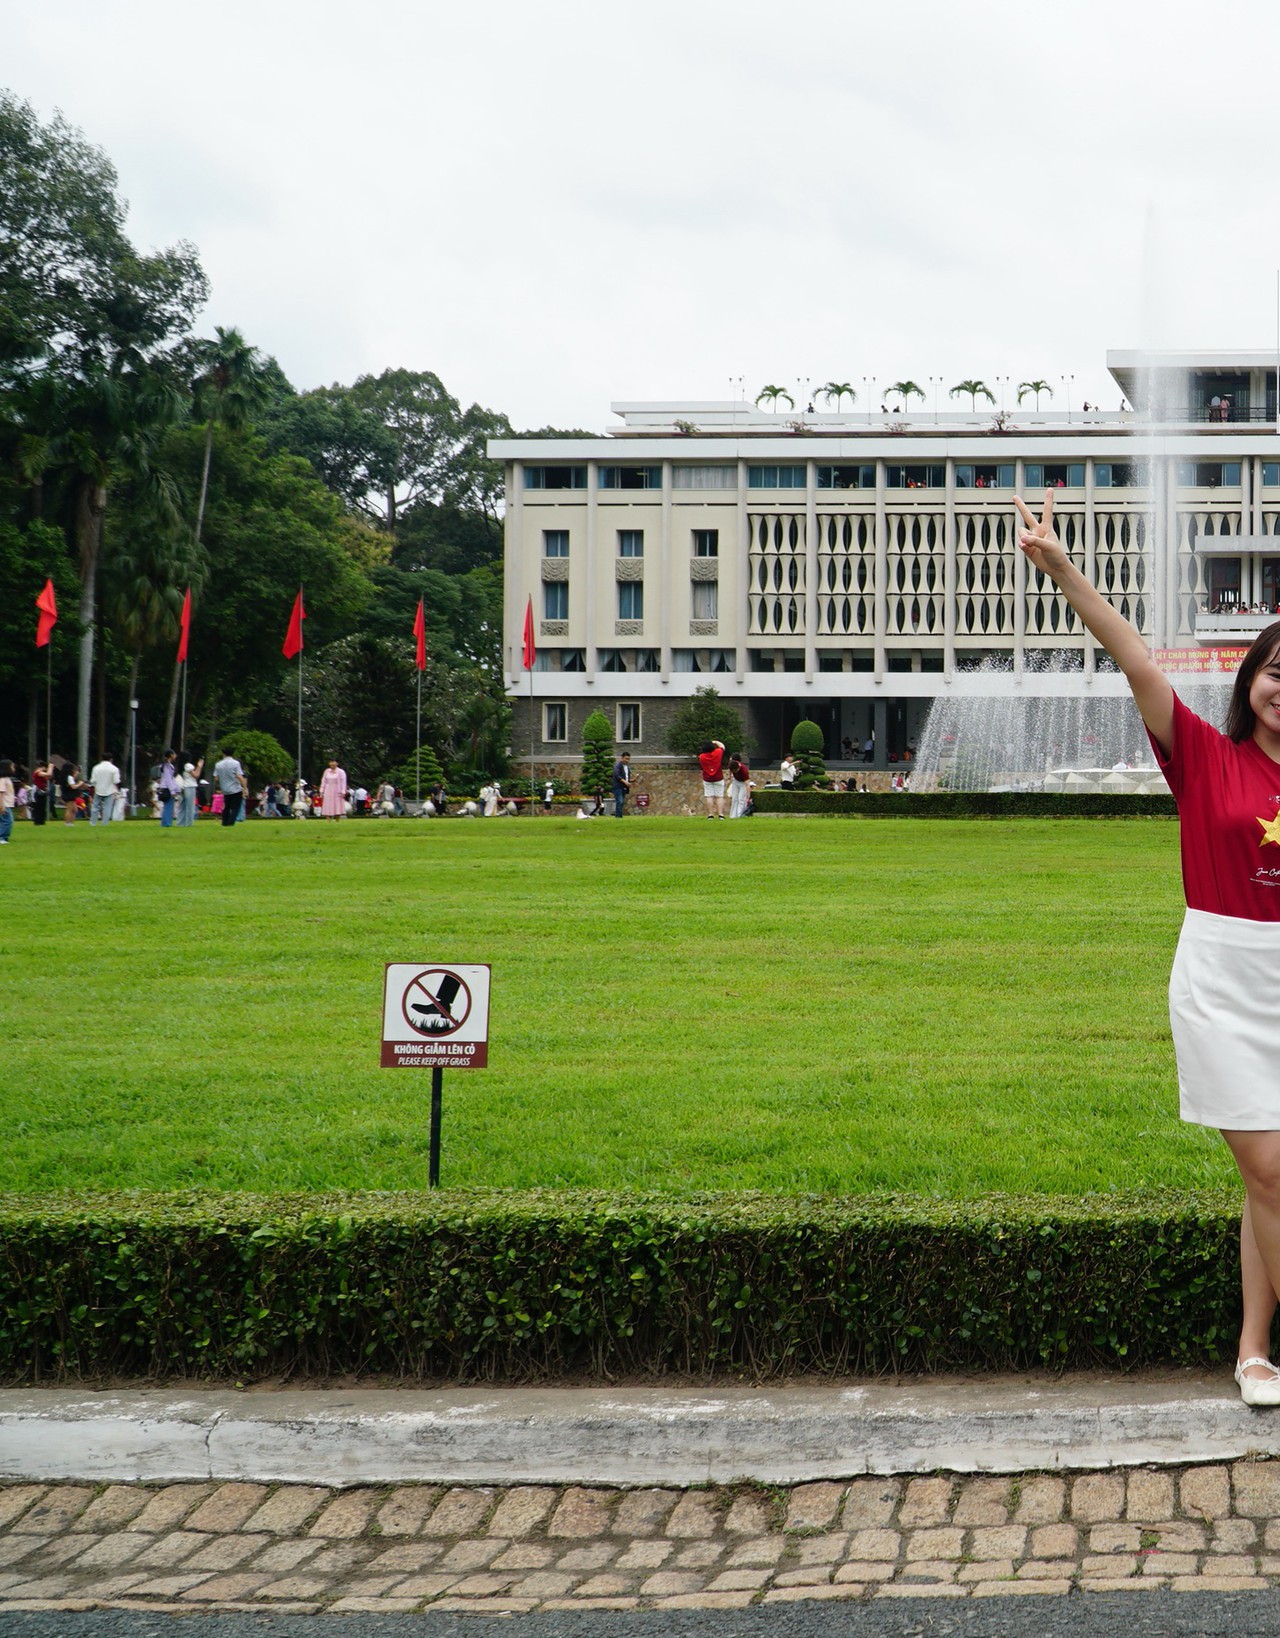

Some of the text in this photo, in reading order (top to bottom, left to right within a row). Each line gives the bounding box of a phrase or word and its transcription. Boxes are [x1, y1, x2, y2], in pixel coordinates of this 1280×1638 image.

[1168, 651, 1187, 659] CHÀO
[1221, 650, 1237, 658] NĂM
[394, 1043, 424, 1054] KHÔNG
[447, 1043, 463, 1054] LÊN
[464, 1043, 476, 1054] CỎ
[397, 1057, 471, 1066] PLEASE KEEP OFF GRASS
